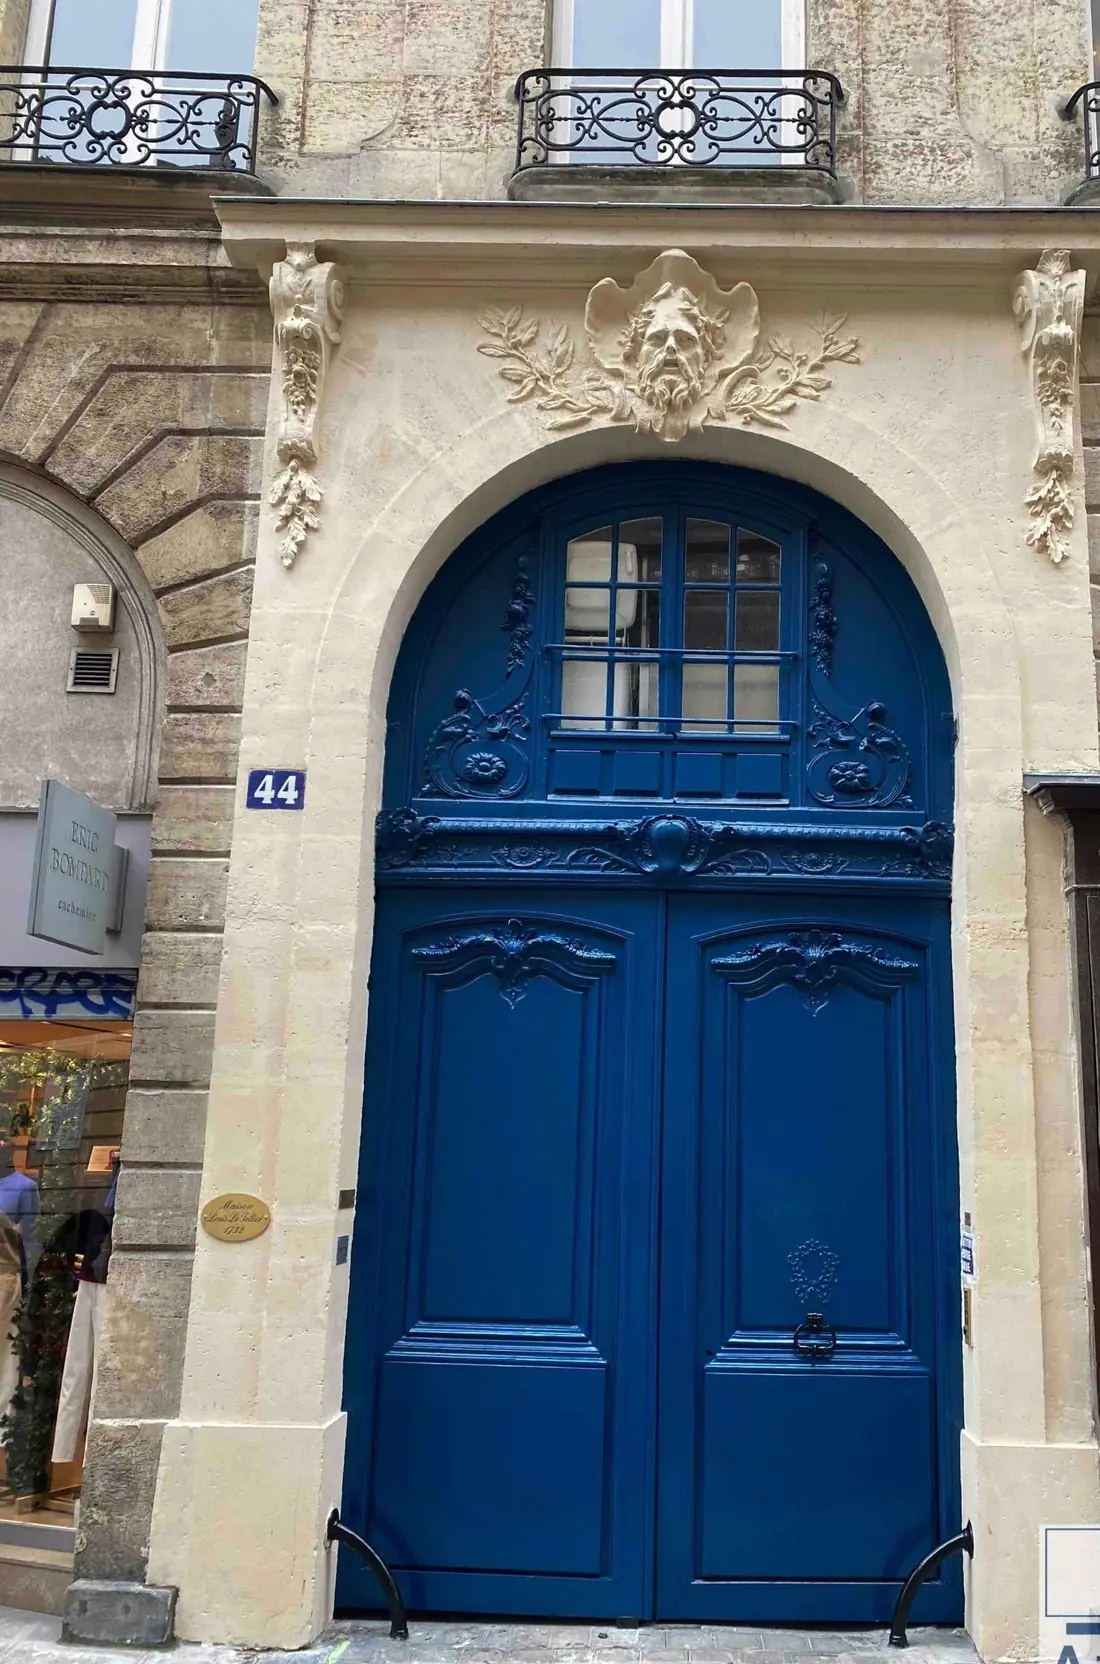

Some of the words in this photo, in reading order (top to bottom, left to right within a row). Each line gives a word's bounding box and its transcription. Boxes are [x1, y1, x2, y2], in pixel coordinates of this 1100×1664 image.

[253, 774, 299, 804] 44
[70, 820, 99, 852] ERIC
[51, 847, 109, 891] BOMPARD
[57, 900, 97, 922] cachemire
[219, 1199, 253, 1209] Maison
